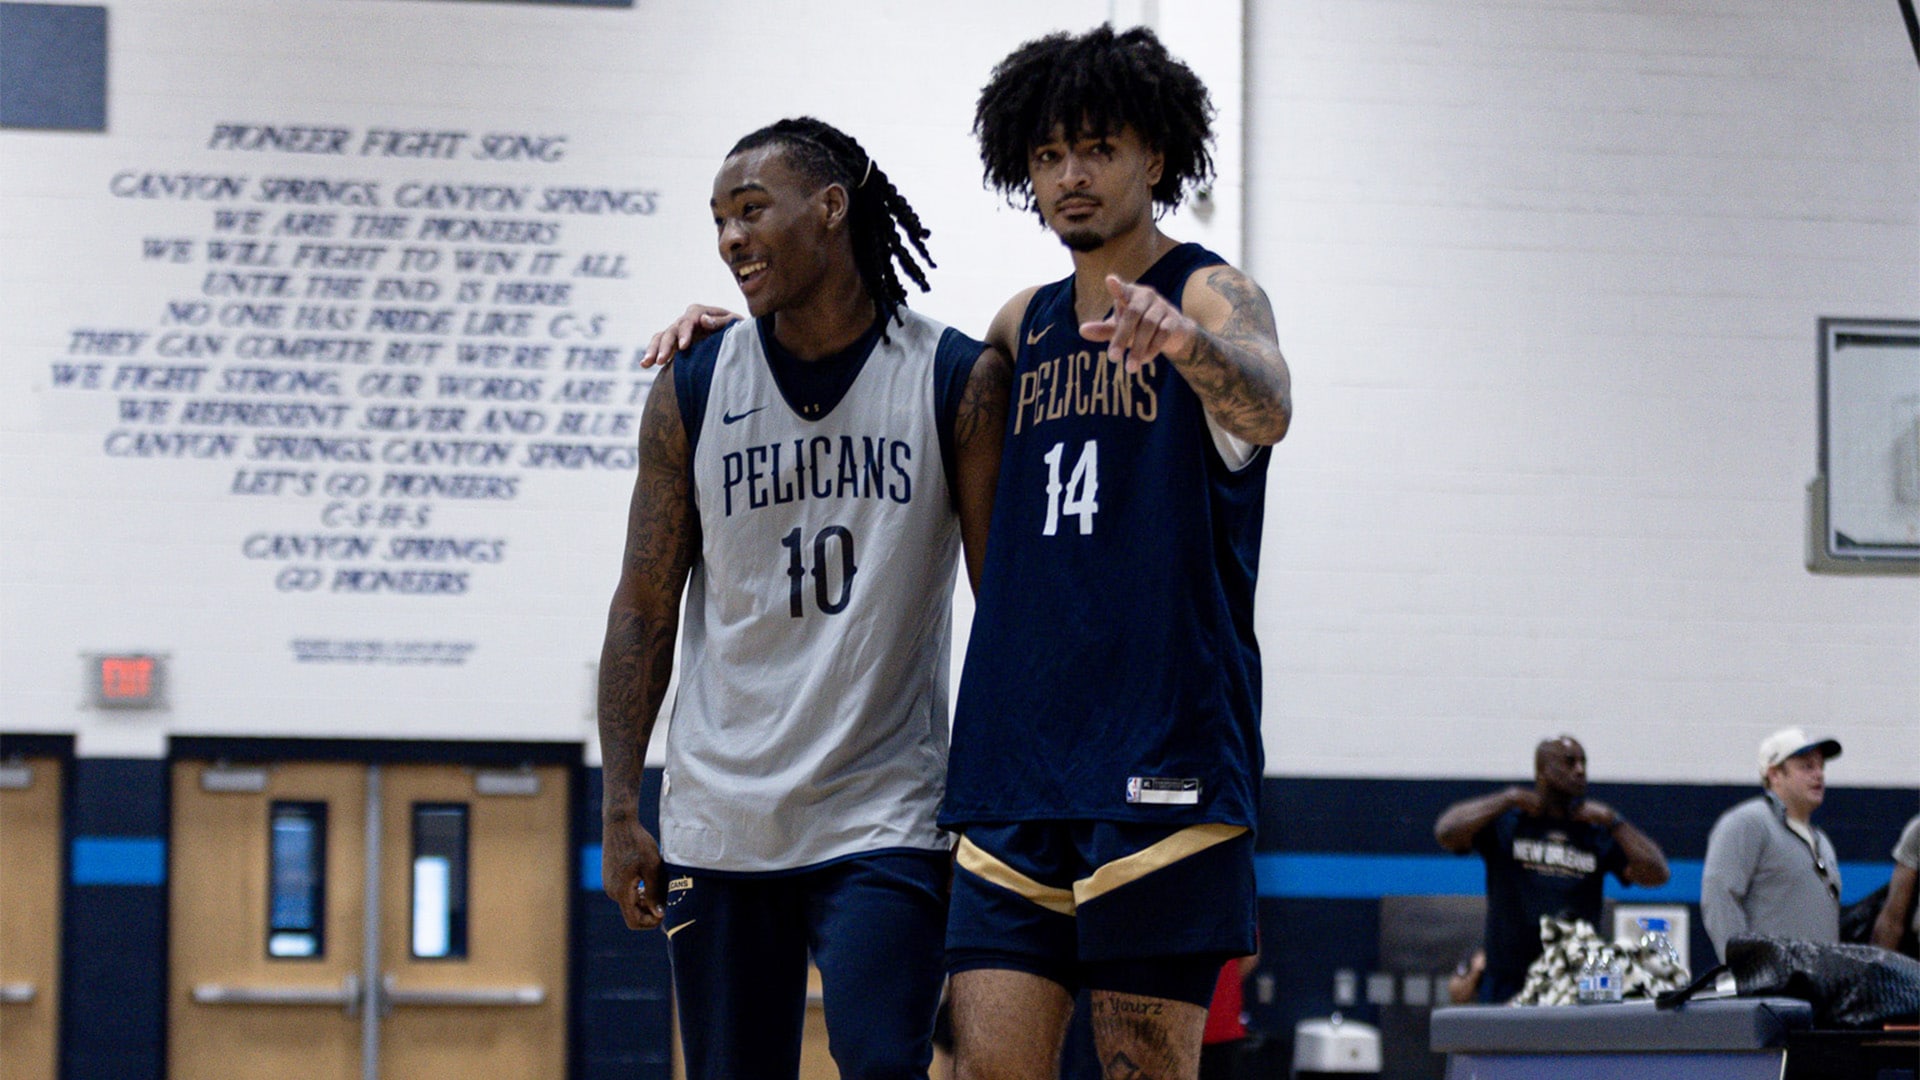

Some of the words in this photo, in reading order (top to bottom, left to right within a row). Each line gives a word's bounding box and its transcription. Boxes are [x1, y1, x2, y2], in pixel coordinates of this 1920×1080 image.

[207, 122, 352, 155] PIONEER
[360, 127, 470, 159] FIGHT
[472, 133, 568, 163] SONG
[110, 172, 250, 201] CANYON
[394, 182, 531, 212] CANYON
[536, 186, 660, 216] SPRINGS
[214, 208, 266, 235] WE
[272, 211, 339, 237] ARE
[350, 212, 412, 240] THE
[418, 216, 561, 245] PIONEERS
[142, 237, 195, 263] WE
[206, 239, 279, 267] WILL
[292, 242, 389, 271] FIGHT
[397, 246, 444, 272] TO
[453, 249, 520, 275] WIN
[529, 250, 564, 275] IT
[573, 254, 628, 279] ALL
[201, 270, 294, 298] UNTIL
[305, 273, 367, 300] THE
[372, 277, 442, 302] END
[456, 279, 484, 303] IS
[492, 280, 573, 306] HERE
[161, 300, 213, 326] NO
[218, 302, 287, 329] ONE
[294, 305, 358, 331] HAS
[365, 306, 456, 335] PRIDE
[463, 310, 536, 337] LIKE
[69, 328, 150, 356] THEY
[156, 332, 228, 358] CAN
[235, 334, 375, 364] COMPETE
[383, 340, 444, 365] BUT
[564, 345, 622, 371] THE
[51, 362, 104, 389] WE
[111, 363, 211, 393] FIGHT
[358, 372, 424, 398] OUR
[437, 373, 545, 402] WORDS
[551, 379, 617, 404] ARE
[1013, 349, 1158, 436] PELICANS
[118, 397, 173, 424] WE
[180, 398, 352, 429] REPRESENT
[358, 405, 468, 433] SILVER
[476, 408, 548, 434] AND
[555, 410, 636, 436] BLUE
[104, 429, 240, 459] CANYON
[381, 437, 515, 466] CANYON
[325, 472, 372, 497] GO
[379, 471, 521, 500] PIONEERS
[722, 435, 913, 516] PELICANS
[1042, 439, 1099, 537] 14
[242, 533, 376, 560] CANYON
[383, 535, 507, 563] SPRINGS
[275, 566, 323, 592] GO
[331, 568, 470, 595] PIONEERS
[781, 525, 858, 619] 10
